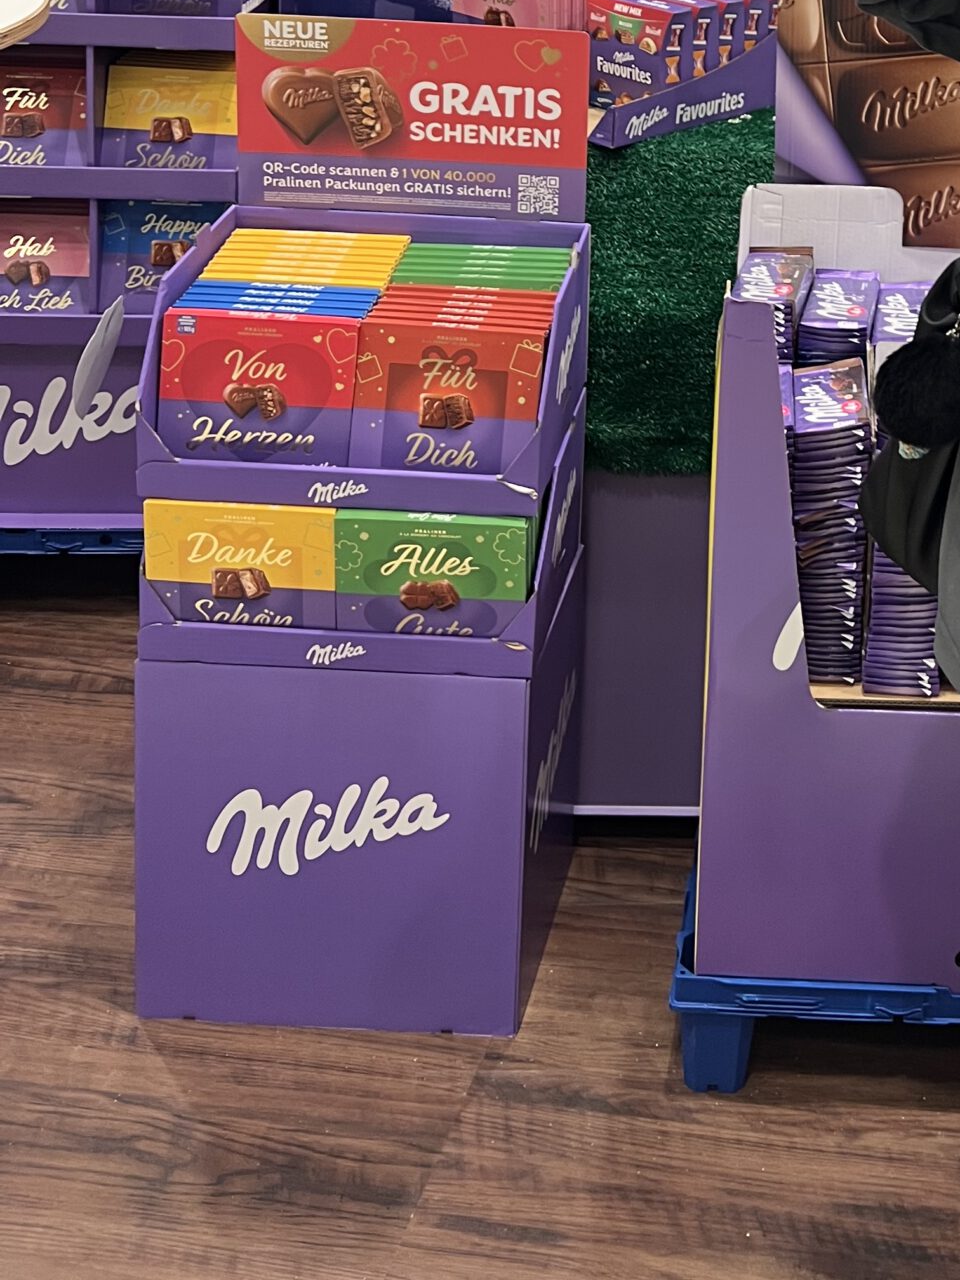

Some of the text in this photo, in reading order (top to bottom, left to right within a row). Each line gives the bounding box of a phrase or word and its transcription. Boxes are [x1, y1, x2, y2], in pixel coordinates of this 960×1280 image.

[263, 20, 329, 40] NEUE
[596, 56, 652, 85] Favourites
[613, 51, 635, 64] Milka
[2, 87, 50, 111] Für
[283, 87, 335, 109] Milka
[409, 81, 562, 120] GRATIS
[625, 92, 745, 139] Milka Favourites
[409, 121, 560, 149] SCHENKEN!
[125, 143, 208, 169] Schön
[263, 161, 497, 184] QR-Code scannen & 1 VON 40.000
[263, 176, 512, 199] Pralinen Packungen GRATIS sichern!
[140, 213, 211, 239] Happy
[4, 235, 57, 258] Hab
[24, 288, 74, 312] Lieb
[224, 349, 287, 381] Von
[419, 358, 478, 390] Für
[0, 377, 138, 466] ilka
[186, 416, 315, 456] Herzen
[405, 433, 478, 470] Dich
[308, 480, 369, 504] Milka
[187, 531, 294, 567] Danke
[380, 544, 480, 578] Alles
[306, 642, 367, 666] Milka
[206, 776, 451, 876] Milka
